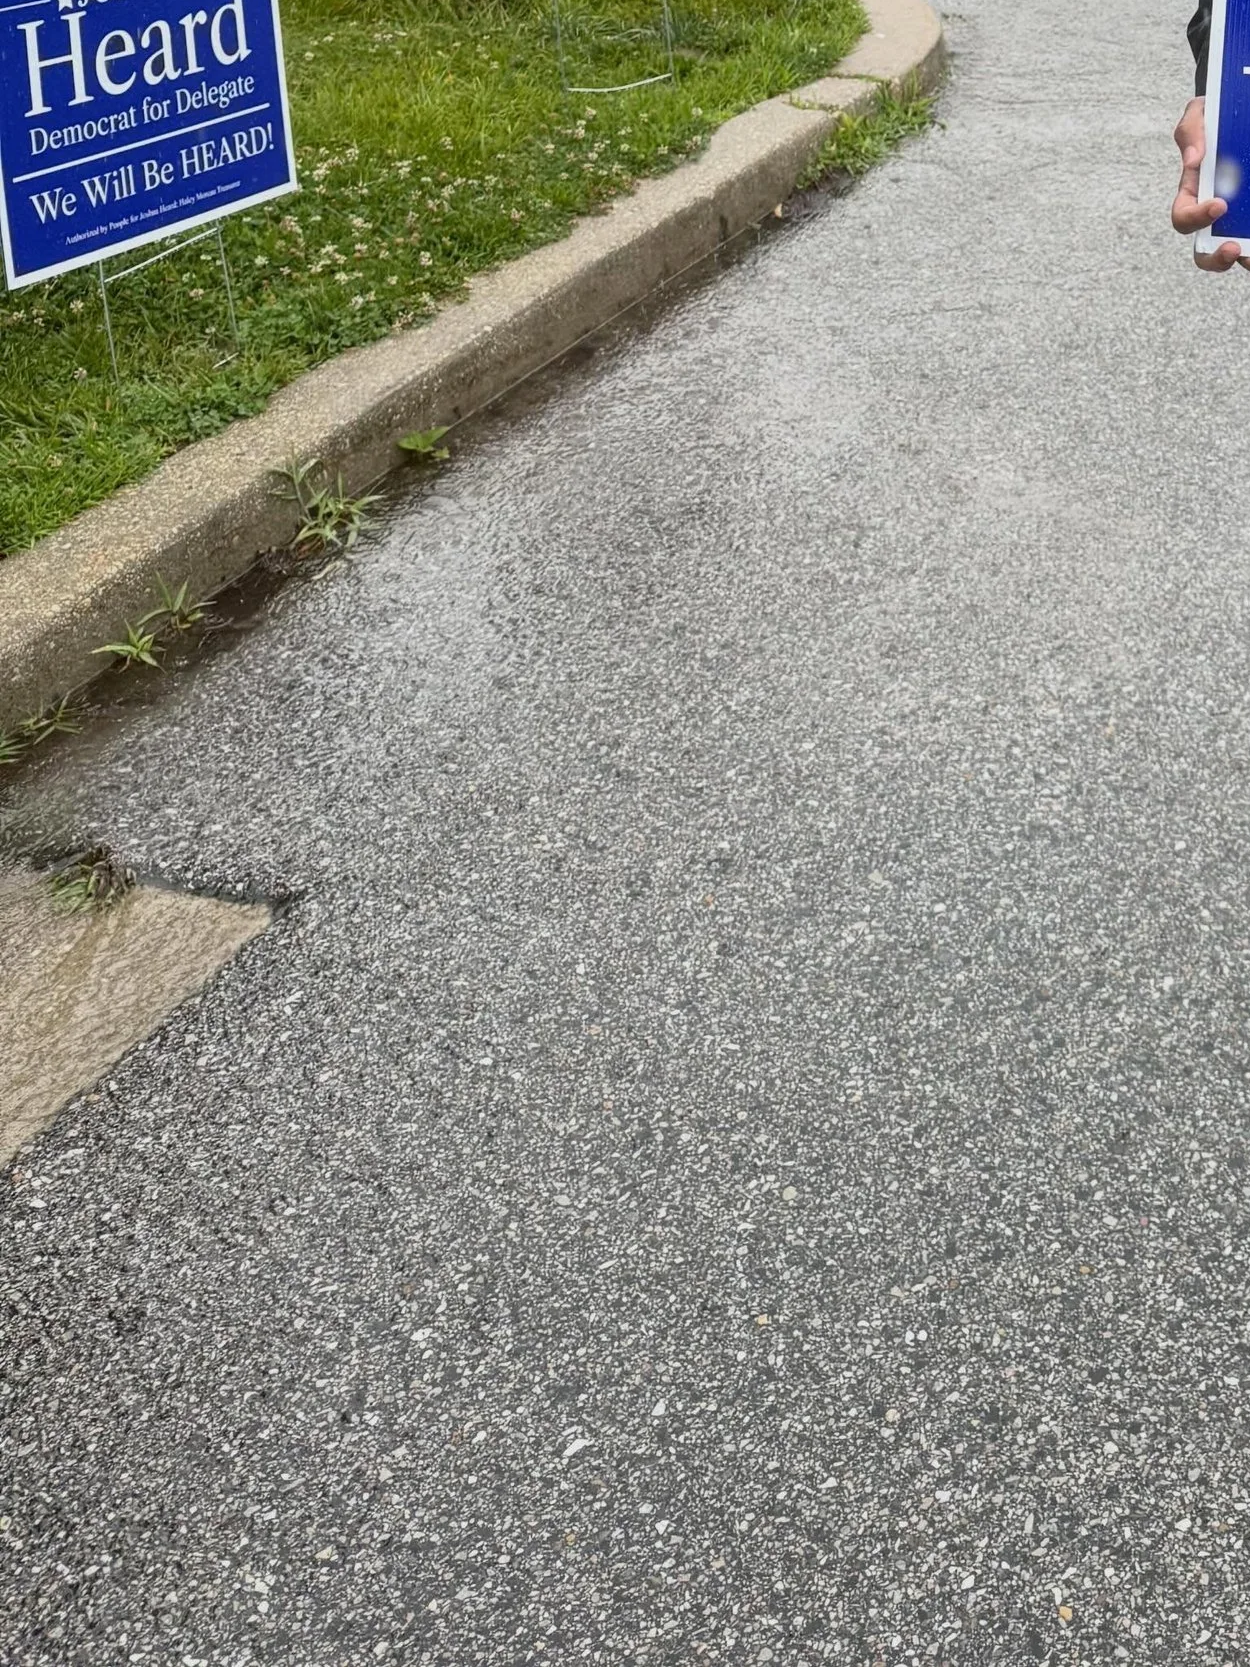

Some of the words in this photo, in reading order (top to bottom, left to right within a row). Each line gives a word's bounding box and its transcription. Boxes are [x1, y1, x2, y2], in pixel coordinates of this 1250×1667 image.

[29, 106, 137, 156] Democrat
[142, 96, 171, 124] for
[175, 74, 255, 114] Delegate
[29, 185, 77, 224] We
[80, 163, 136, 208] Will
[141, 158, 174, 191] Be
[179, 121, 275, 179] HEARD!
